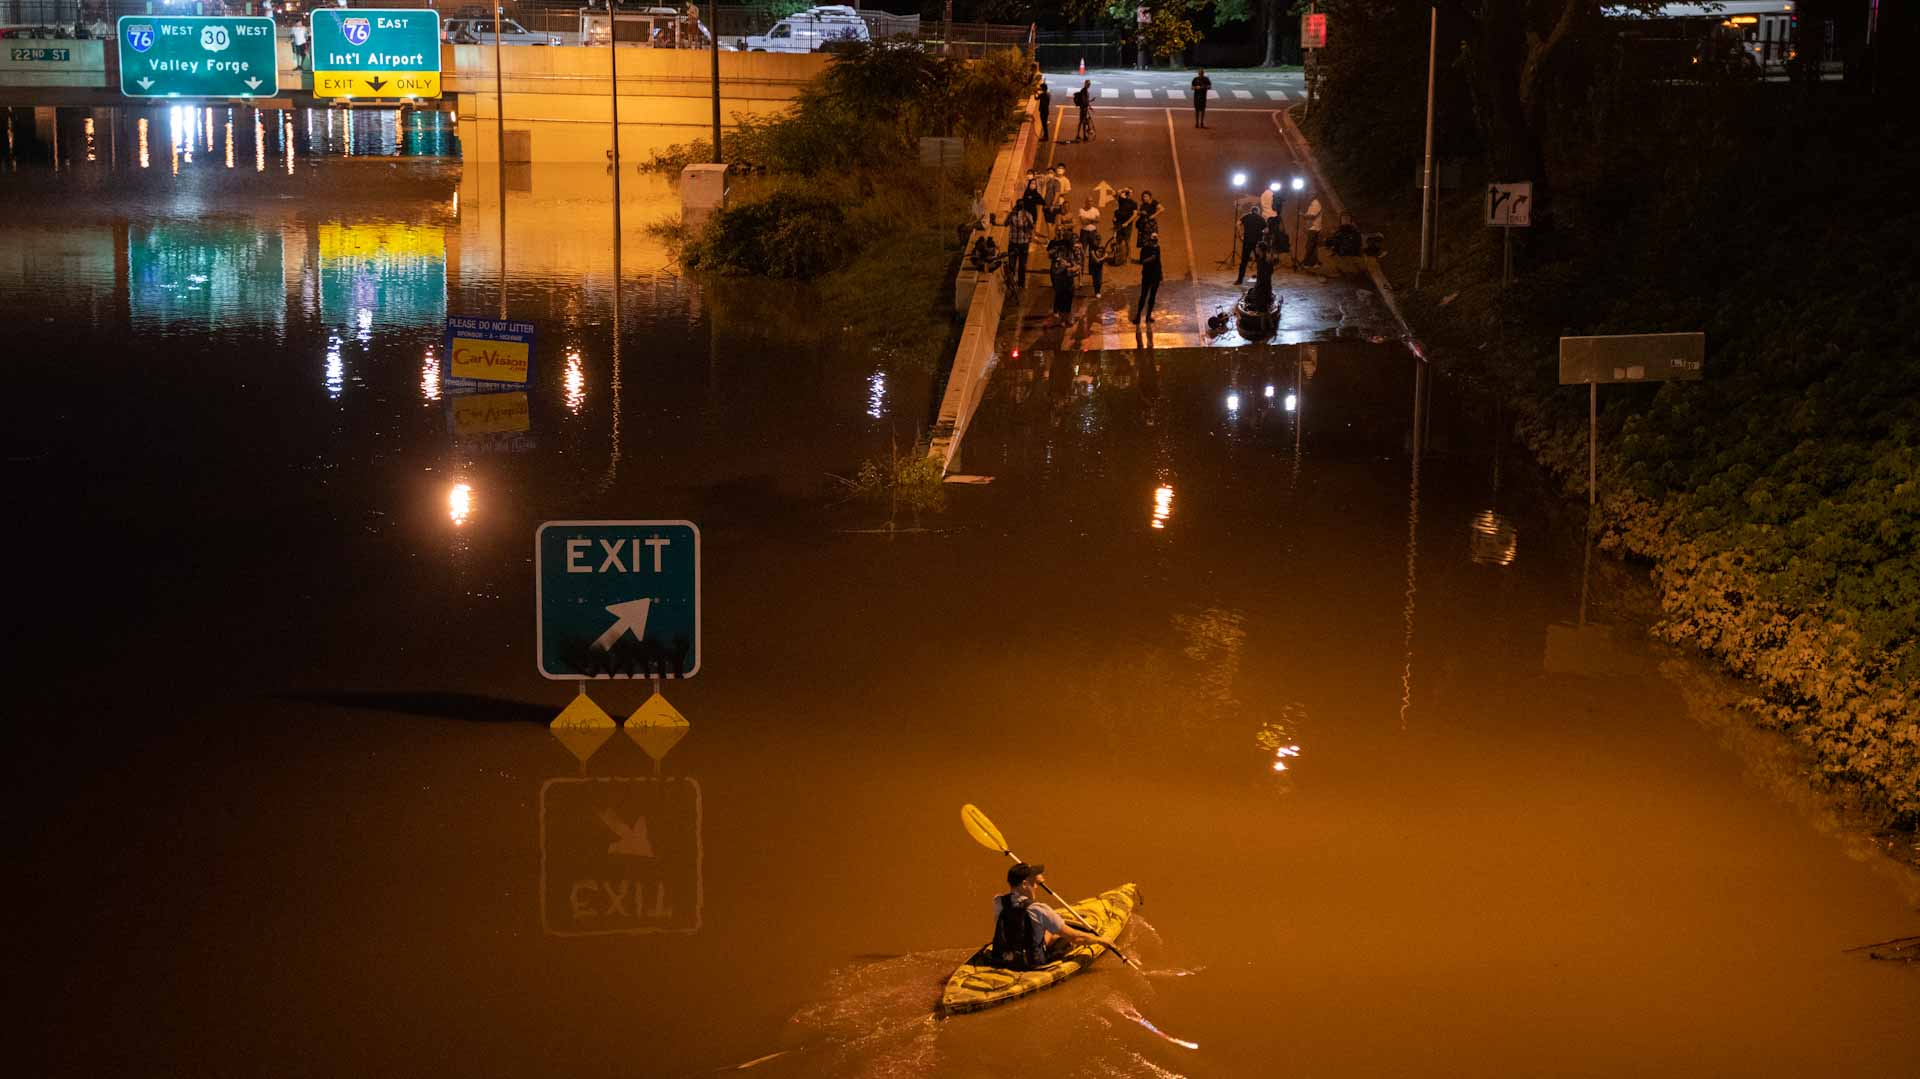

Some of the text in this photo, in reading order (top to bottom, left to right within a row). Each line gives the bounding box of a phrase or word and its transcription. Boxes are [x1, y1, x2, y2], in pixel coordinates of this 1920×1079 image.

[130, 31, 152, 47] 76
[161, 24, 193, 36] WEST
[204, 31, 226, 45] 30
[235, 24, 268, 36] WEST
[346, 17, 409, 41] 76 EAST
[15, 49, 67, 60] 22ND ST
[329, 52, 424, 67] Int'l Airport
[149, 59, 249, 74] Valley Forge
[324, 79, 432, 89] EXIT ONLY
[448, 318, 534, 334] PLEASE DO NOT LITTER
[453, 347, 527, 369] CarVision
[566, 538, 671, 573] EXIT
